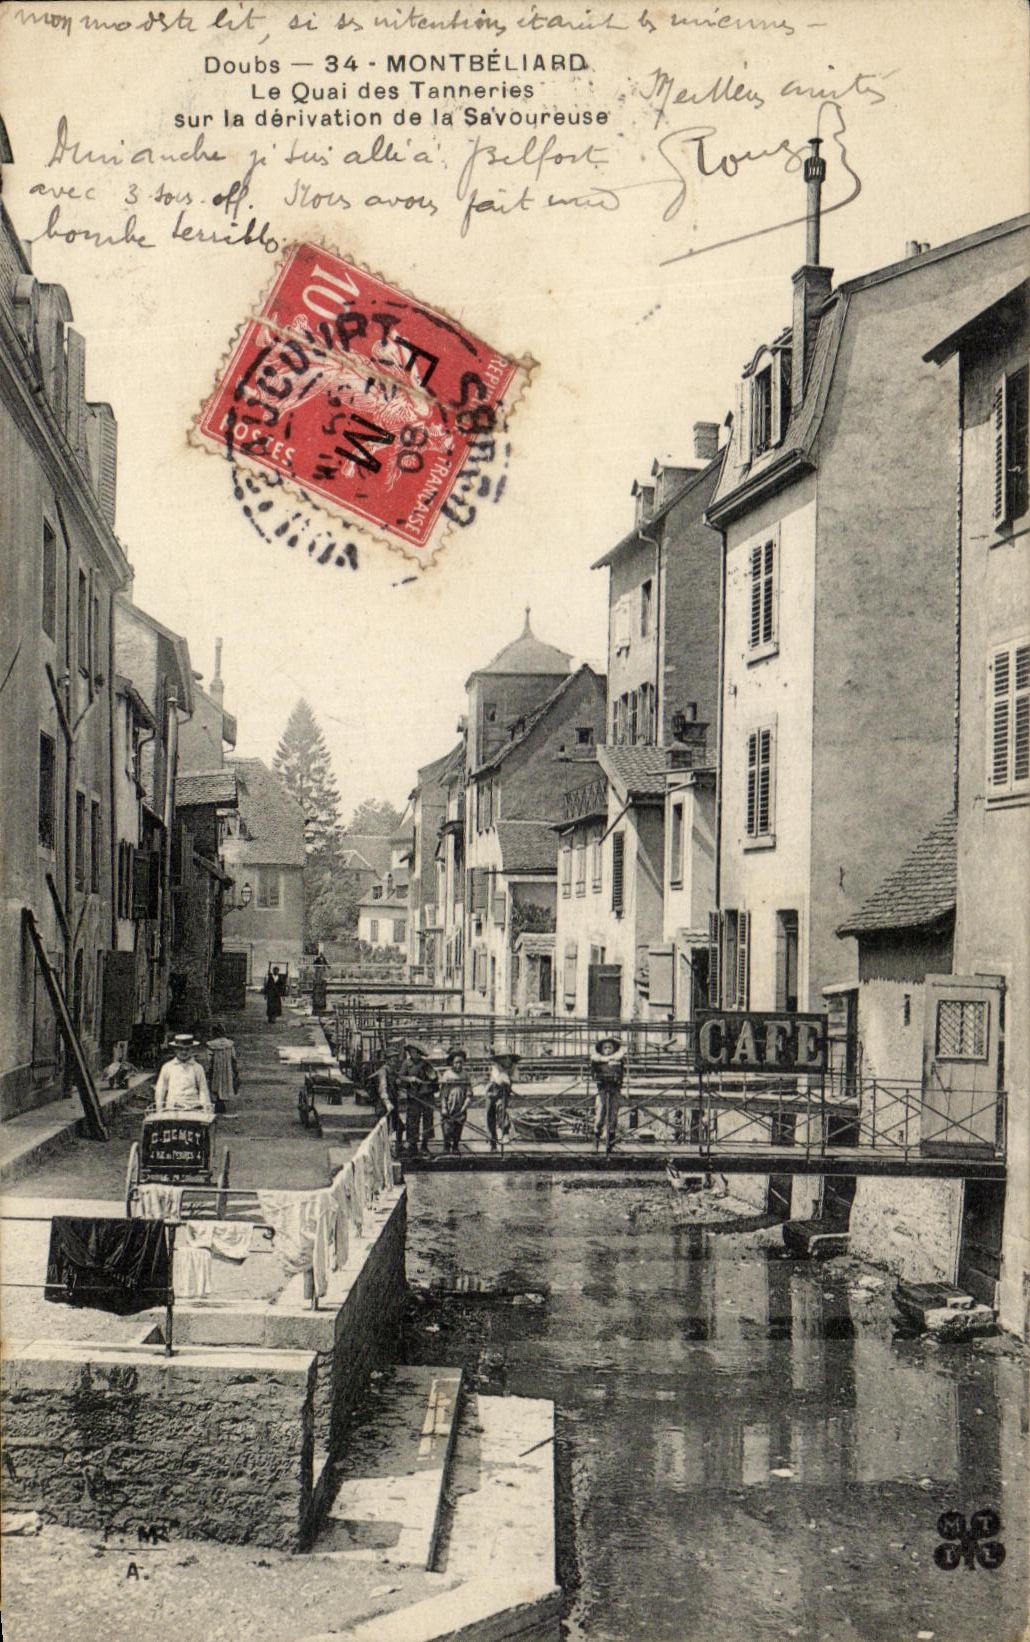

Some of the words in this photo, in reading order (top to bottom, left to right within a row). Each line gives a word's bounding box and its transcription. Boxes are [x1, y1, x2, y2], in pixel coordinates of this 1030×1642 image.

[28, 183, 97, 203] avec
[124, 183, 139, 206] 3
[301, 263, 361, 323] 10
[394, 333, 440, 388] F
[699, 1018, 824, 1066] CAFE
